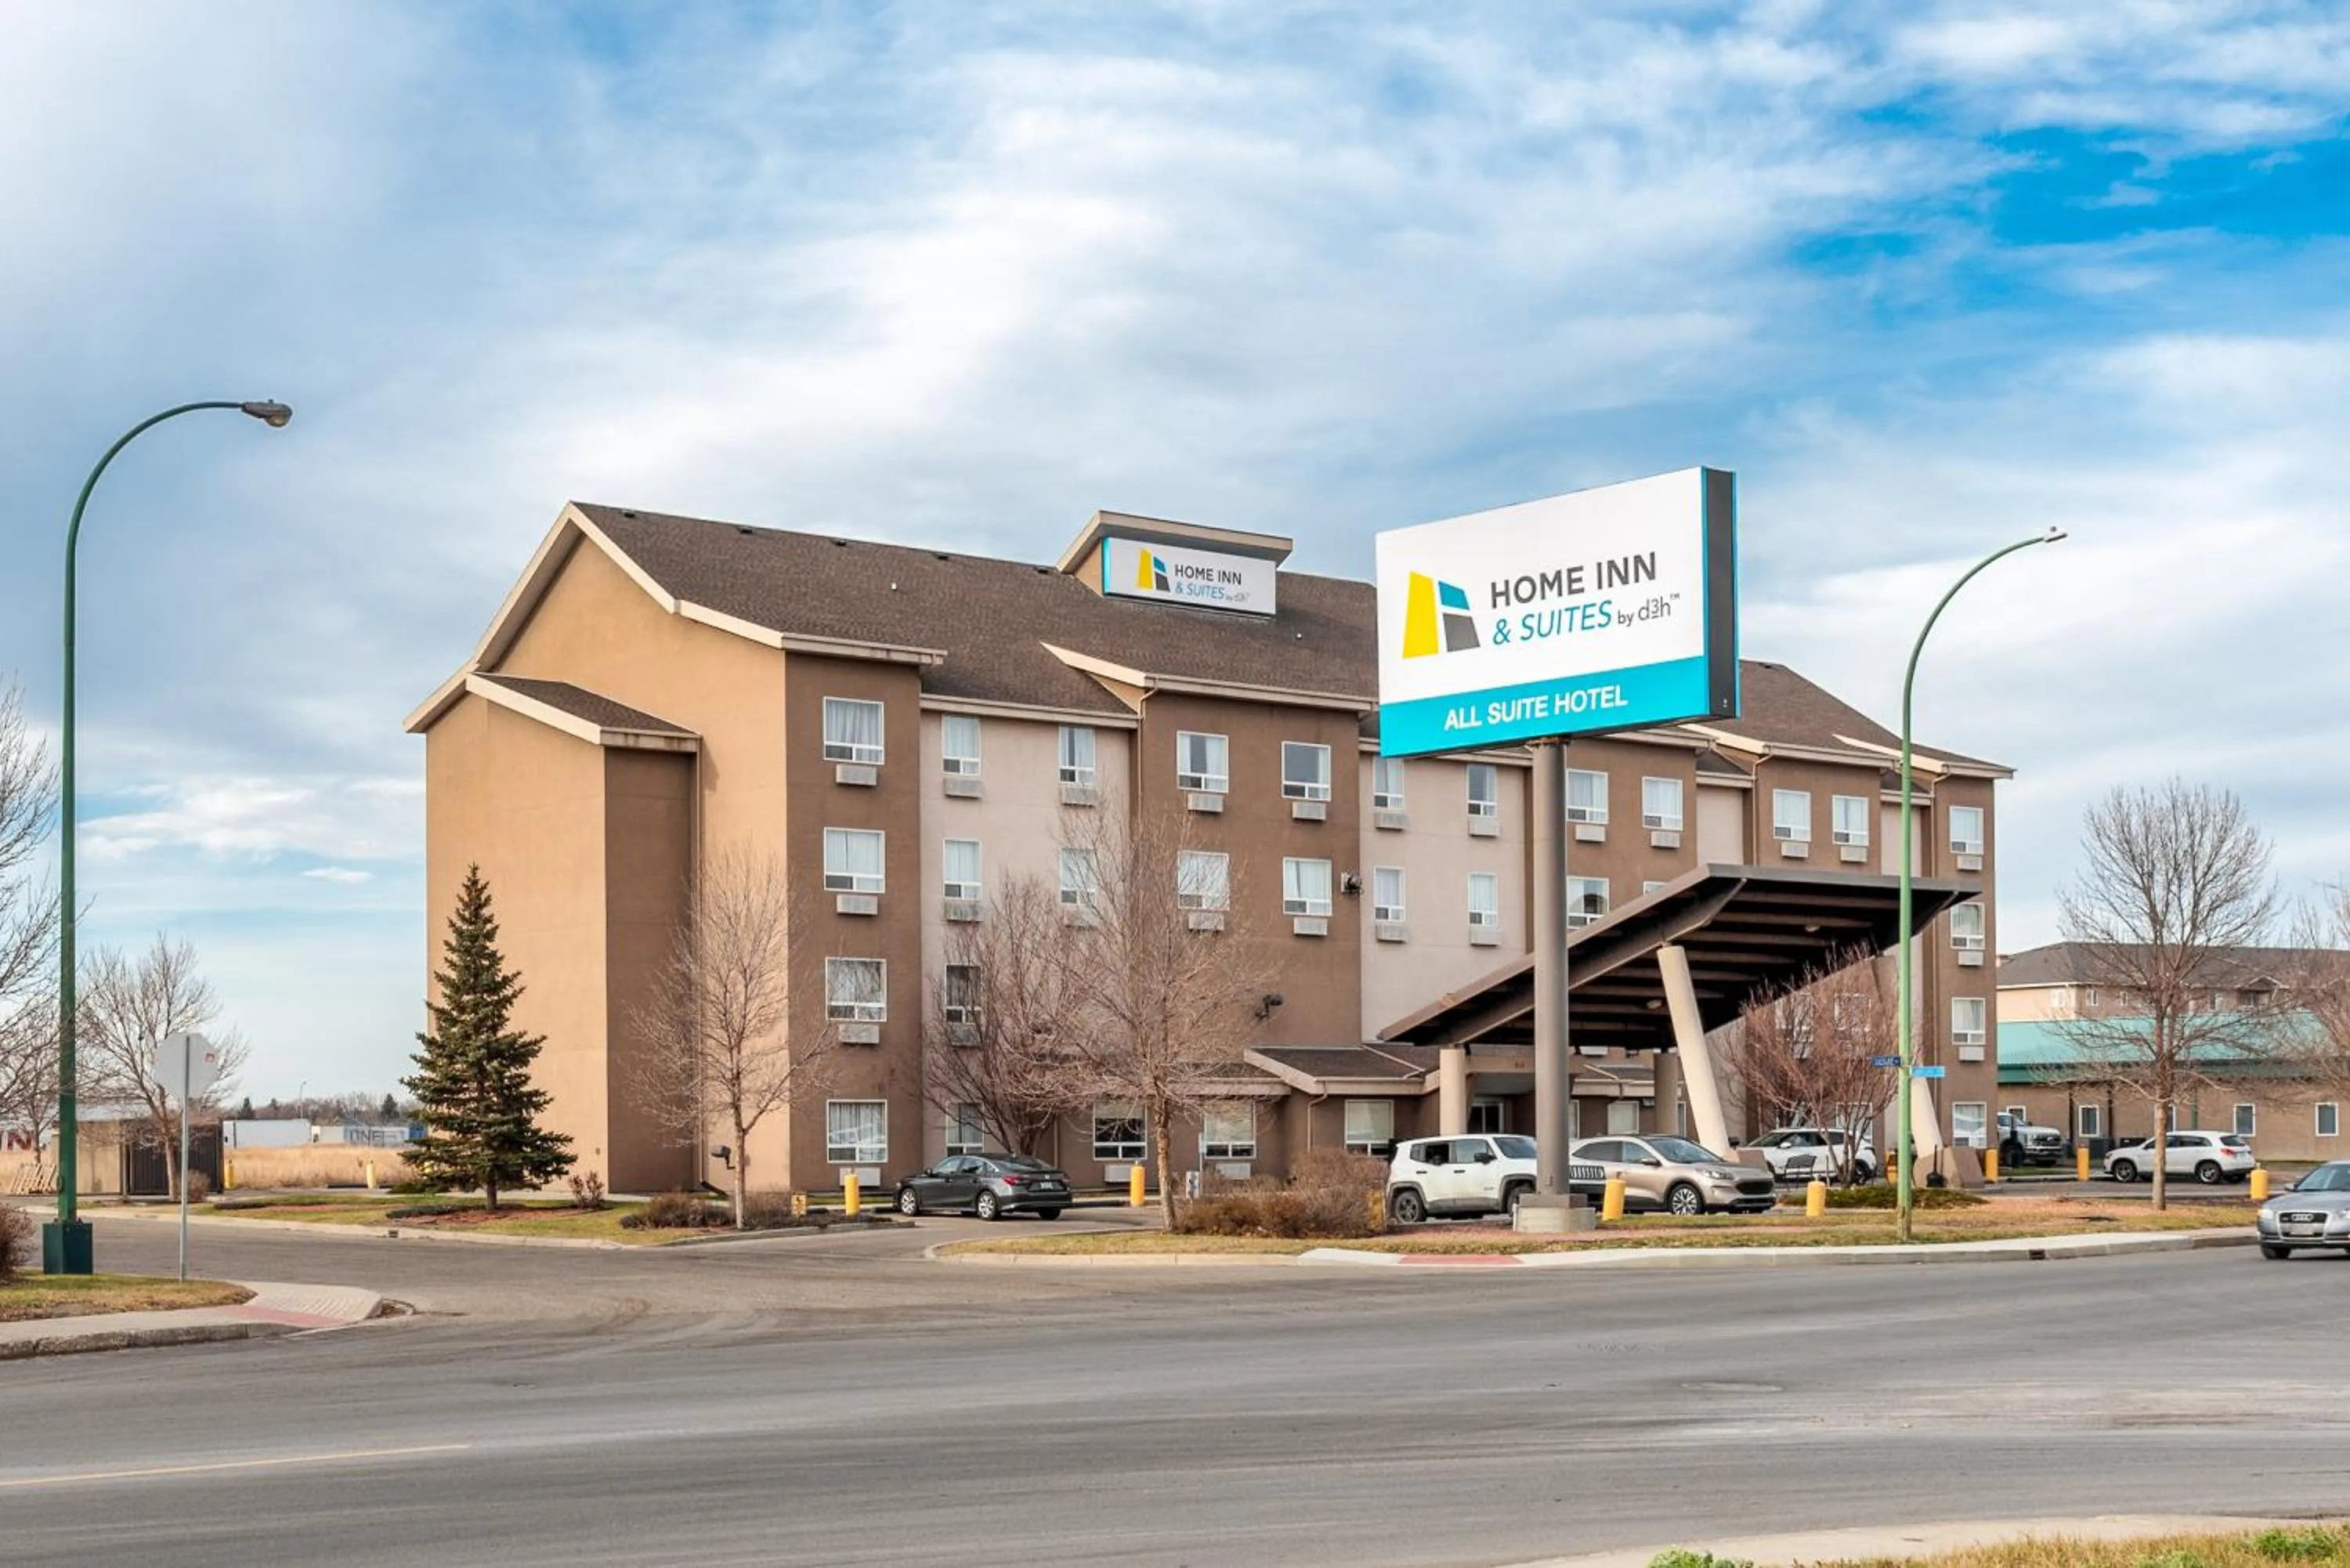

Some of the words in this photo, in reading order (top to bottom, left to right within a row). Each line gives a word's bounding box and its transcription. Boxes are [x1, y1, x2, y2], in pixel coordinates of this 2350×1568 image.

[1174, 564, 1214, 582] HOME
[1217, 570, 1242, 585] INN
[1175, 581, 1183, 594] &
[1186, 582, 1225, 599] SUITES
[1491, 565, 1585, 609] HOME
[1596, 551, 1656, 590] INN
[1492, 618, 1511, 645] &
[1520, 600, 1612, 641] SUITES
[1618, 609, 1635, 627] by
[1444, 706, 1482, 732] ALL
[1487, 695, 1549, 725] SUITE
[1554, 685, 1629, 715] HOTEL
